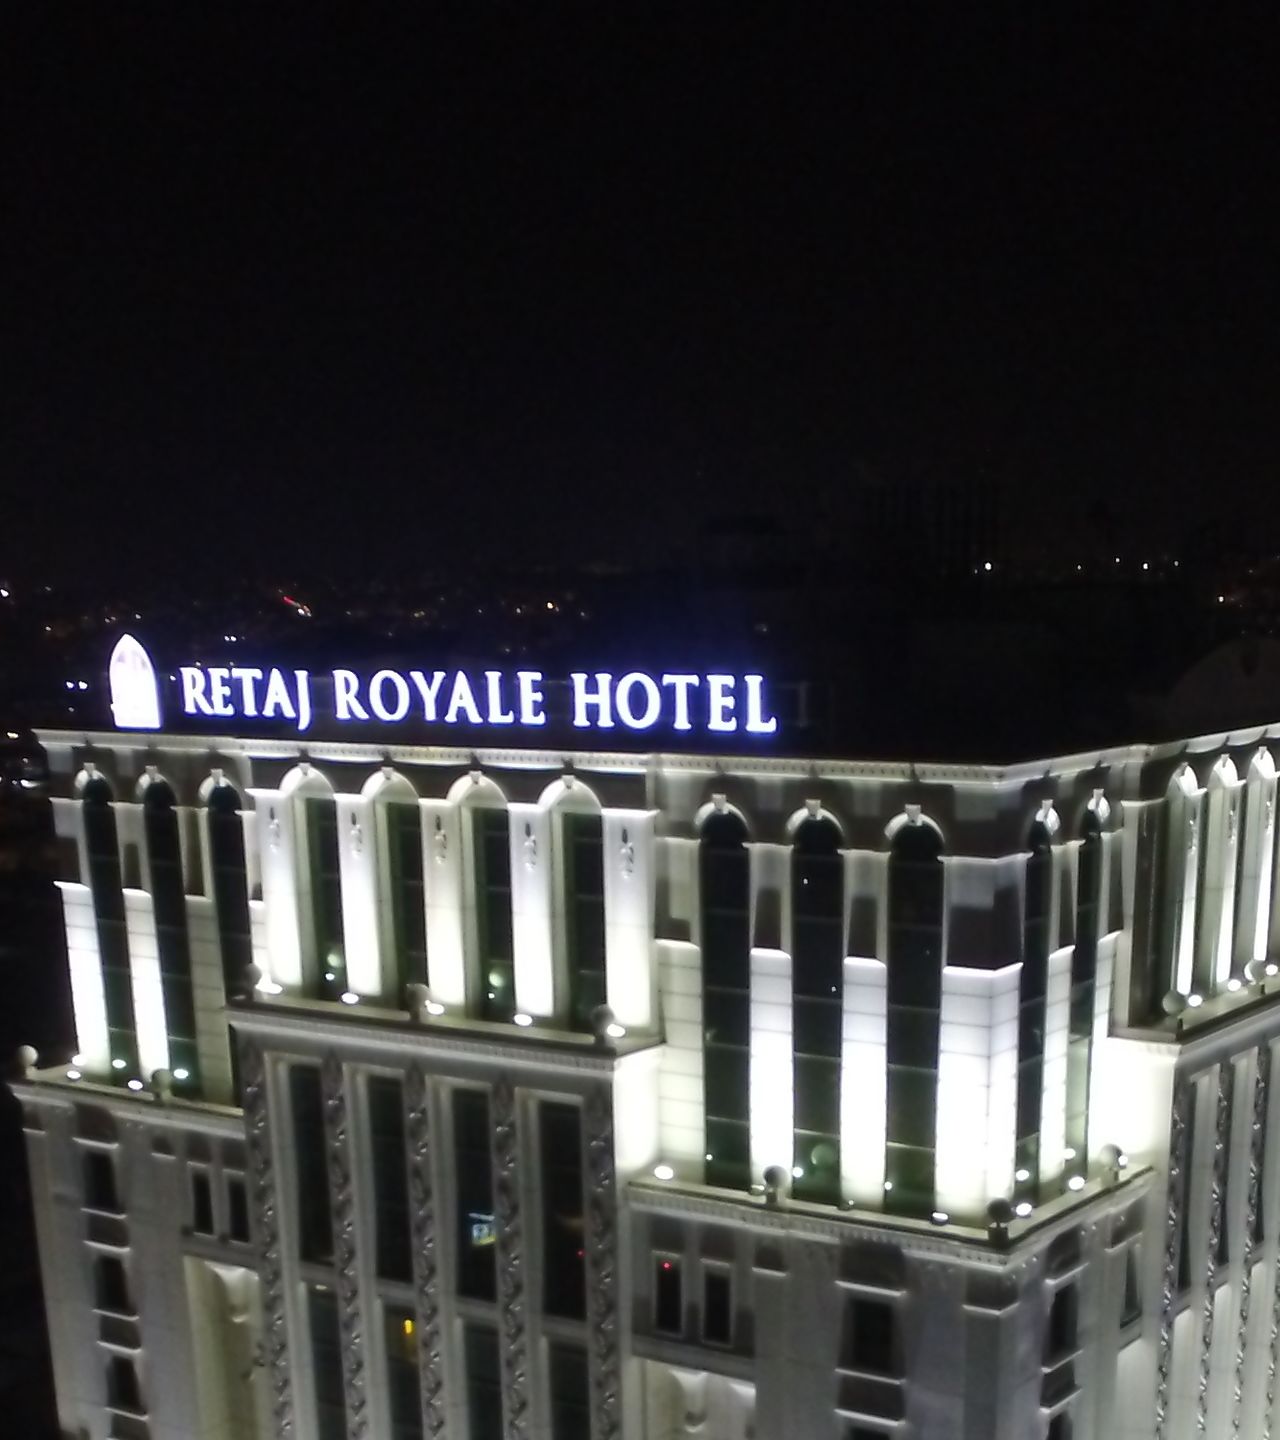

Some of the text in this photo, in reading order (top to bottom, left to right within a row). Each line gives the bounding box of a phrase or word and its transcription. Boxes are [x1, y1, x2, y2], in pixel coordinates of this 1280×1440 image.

[179, 666, 777, 733] RETAJ ROYALE HOTEL
